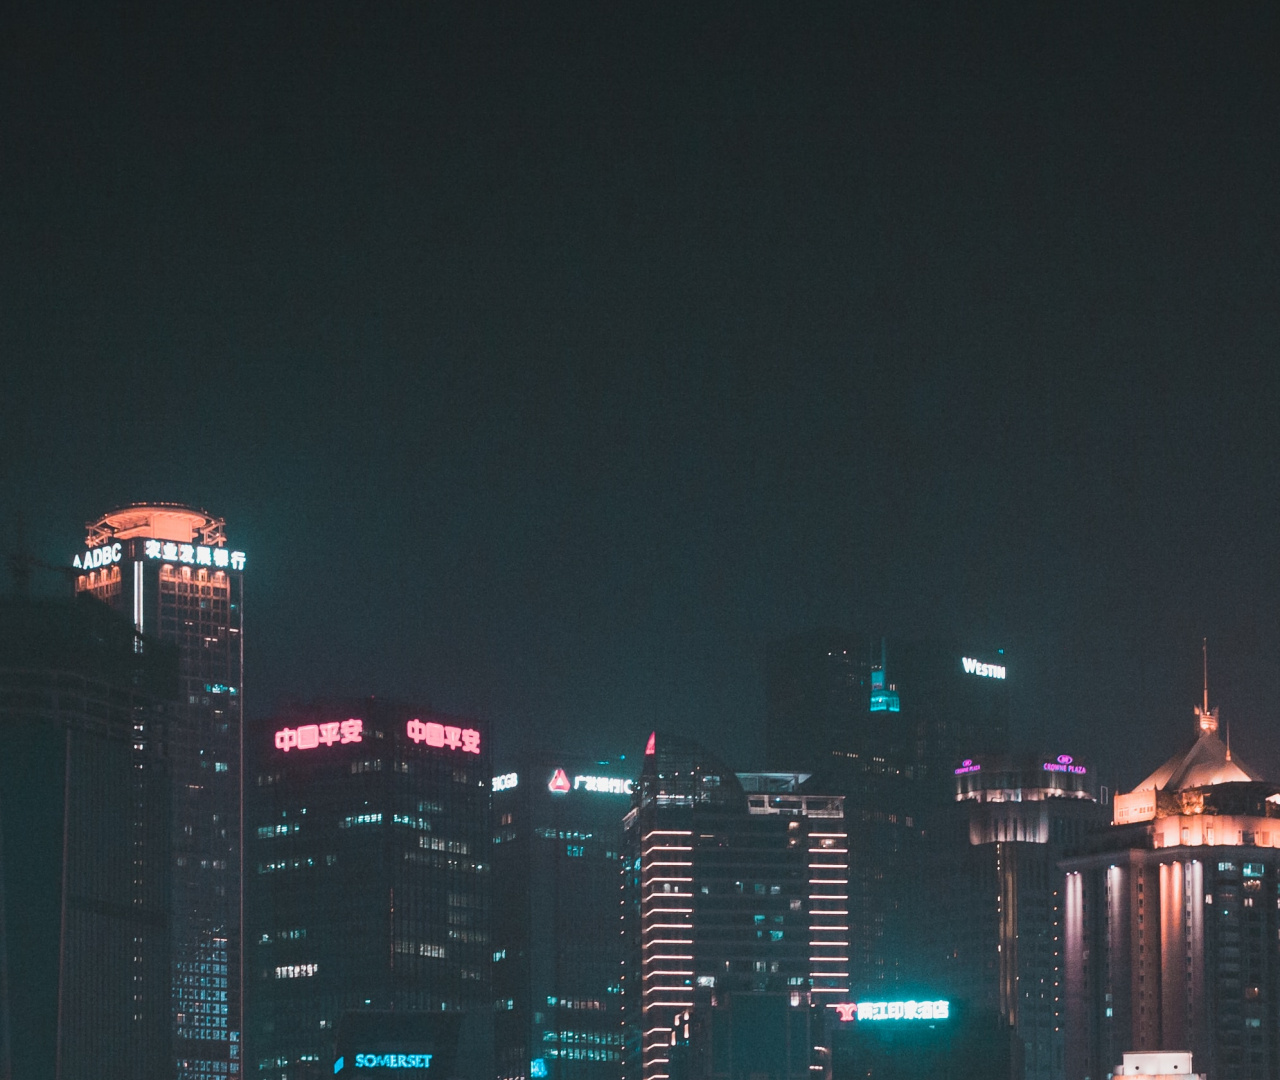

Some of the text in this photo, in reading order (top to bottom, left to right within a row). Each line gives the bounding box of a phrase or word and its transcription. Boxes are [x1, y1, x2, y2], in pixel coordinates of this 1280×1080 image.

[83, 542, 122, 570] ADBC
[145, 539, 247, 570] 农业发展银行
[275, 718, 363, 752] 中国平安
[407, 718, 480, 754] 中国平安
[1043, 763, 1086, 774] CROWNE PLAZA
[355, 1053, 433, 1068] SOMERSET
